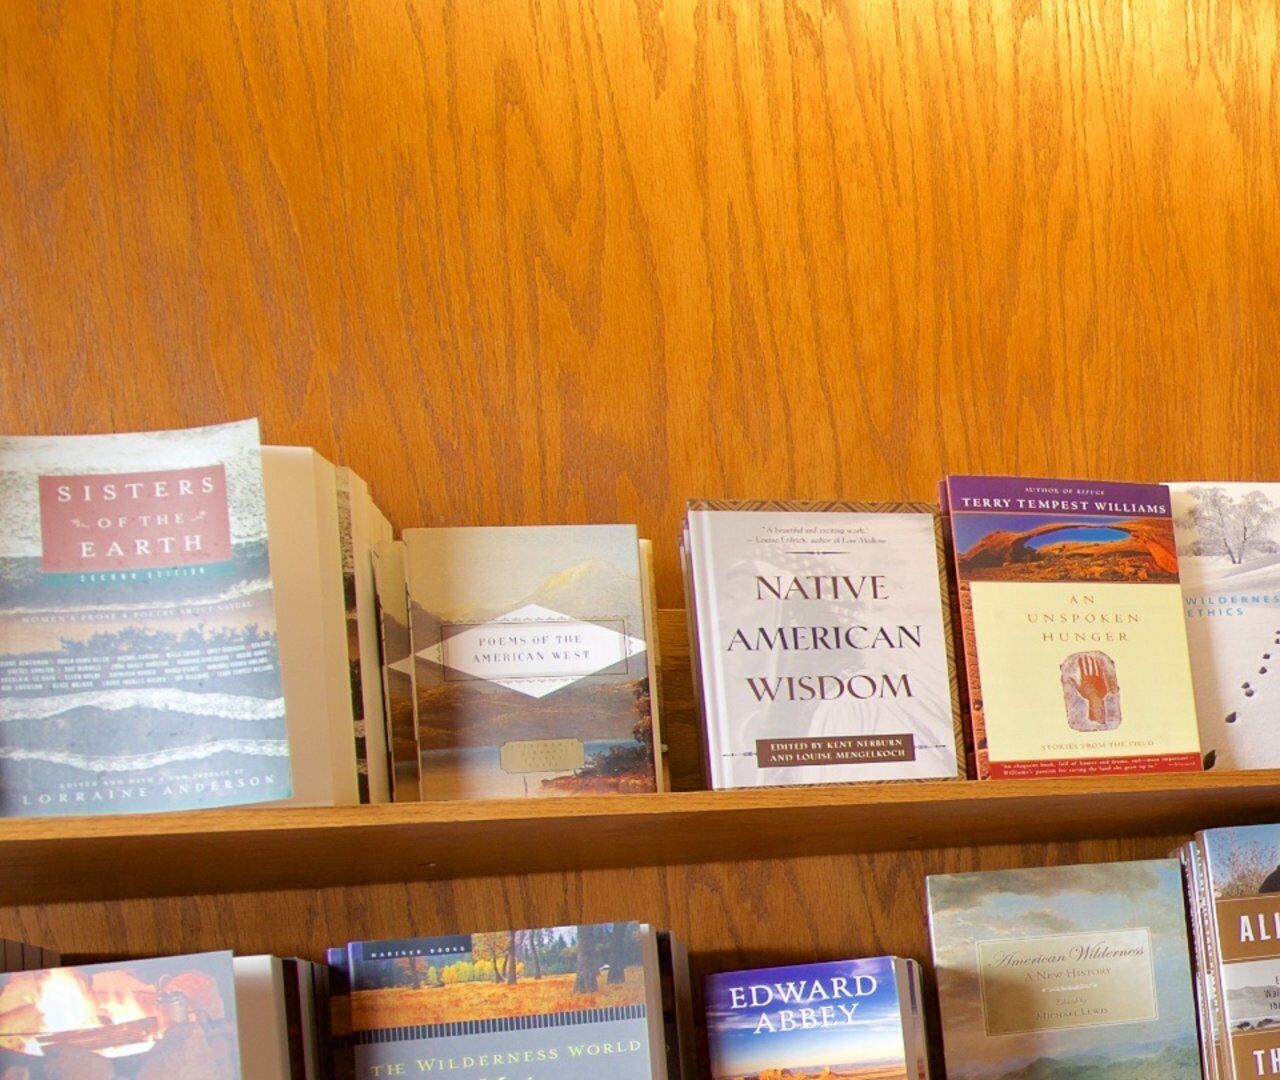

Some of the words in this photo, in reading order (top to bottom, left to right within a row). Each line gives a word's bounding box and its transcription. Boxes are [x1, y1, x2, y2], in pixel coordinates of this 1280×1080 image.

[57, 476, 215, 503] SISTERS
[961, 497, 1012, 509] TERRY
[1017, 499, 1089, 511] TEMPEST
[1094, 502, 1167, 515] WILLIAMS
[97, 516, 128, 530] OF
[139, 513, 185, 529] THE
[80, 534, 203, 559] EARTH
[755, 575, 889, 601] NATIVE
[1070, 595, 1095, 605] AN
[1027, 613, 1141, 624] UNSPOKEN
[1186, 607, 1244, 618] ETHICS
[478, 635, 527, 647] POEMS
[532, 634, 551, 645] OF
[555, 633, 583, 645] THE
[726, 623, 923, 652] AMERICAN
[1042, 632, 1130, 643] HUNGER
[472, 651, 546, 664] AMERICAN
[551, 649, 591, 661] WEST
[746, 673, 914, 702] WISDOM
[771, 742, 808, 751] EDITED
[812, 741, 824, 750] BY
[827, 740, 852, 749] KENT
[856, 737, 903, 748] NERBURN
[769, 752, 793, 763] AND
[796, 751, 833, 761] LOUISE
[836, 748, 906, 761] MENGELKOCH
[22, 786, 150, 807] LORRAINE
[162, 773, 277, 797] ANDERSON
[371, 948, 423, 959] MARINER
[430, 945, 466, 955] BOOKS
[986, 949, 1067, 971] American
[1066, 939, 1146, 964] Wilderness
[1024, 971, 1034, 983] A
[1036, 970, 1064, 981] NEW
[1065, 966, 1113, 980] HISTORY
[728, 973, 879, 1010] EDWARD
[752, 1002, 861, 1035] ABBEY
[370, 1061, 407, 1078] THE
[416, 1047, 560, 1074] WILDERNESS
[567, 1039, 643, 1057] WORLD
